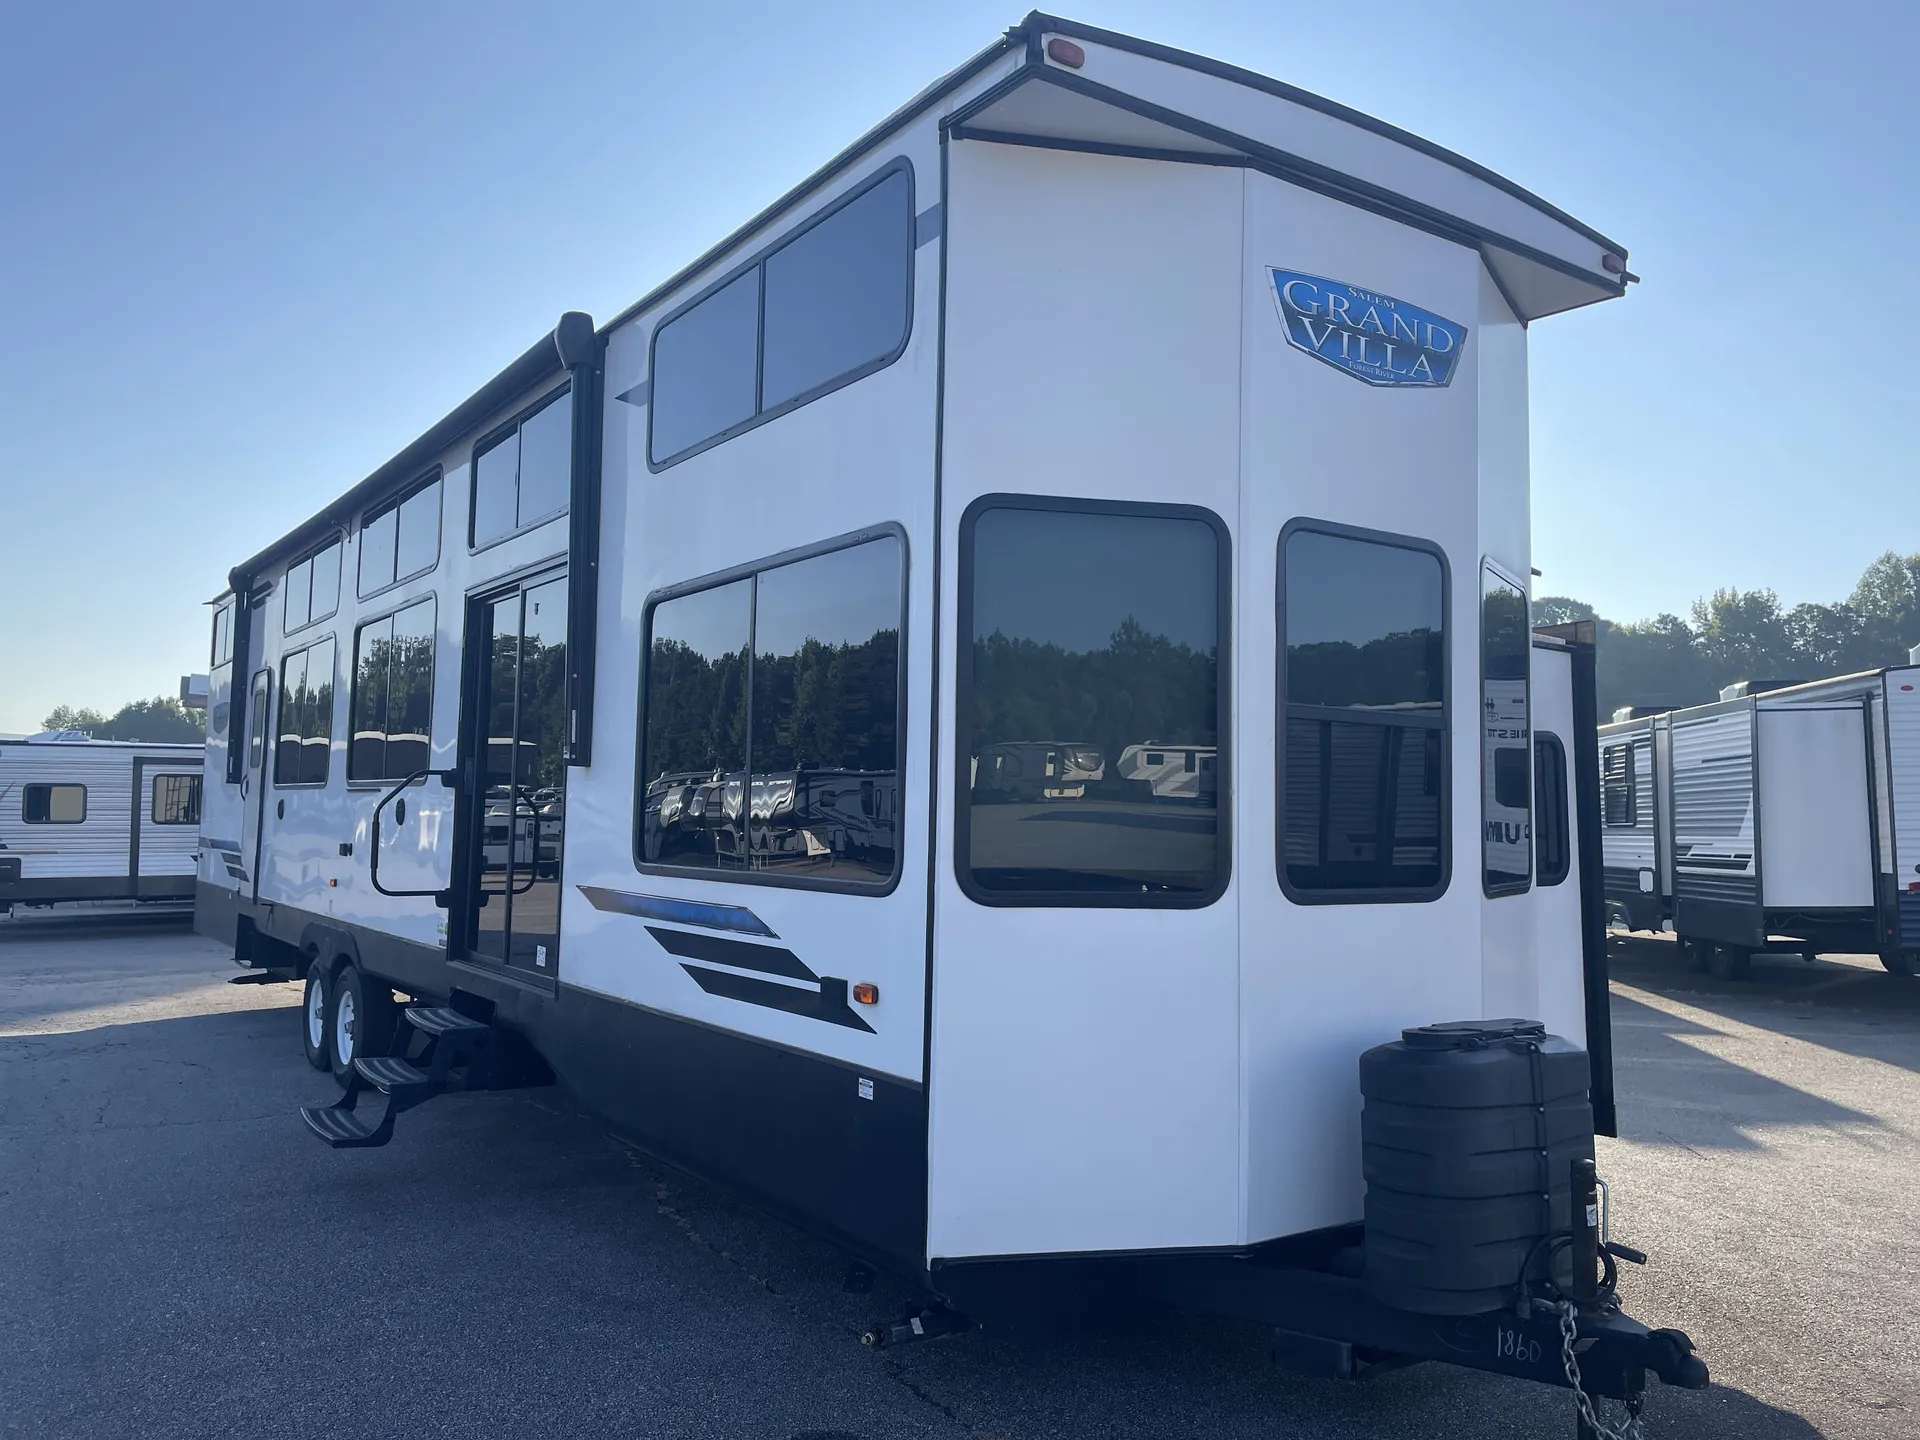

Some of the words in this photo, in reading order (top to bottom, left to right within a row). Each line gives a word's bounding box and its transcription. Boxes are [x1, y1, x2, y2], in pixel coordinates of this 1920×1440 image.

[1283, 280, 1454, 353] GRAND
[1348, 286, 1396, 310] SALEM
[1297, 315, 1439, 382] VILLA
[1375, 368, 1395, 380] RIVER
[1497, 1325, 1542, 1362] 1860
